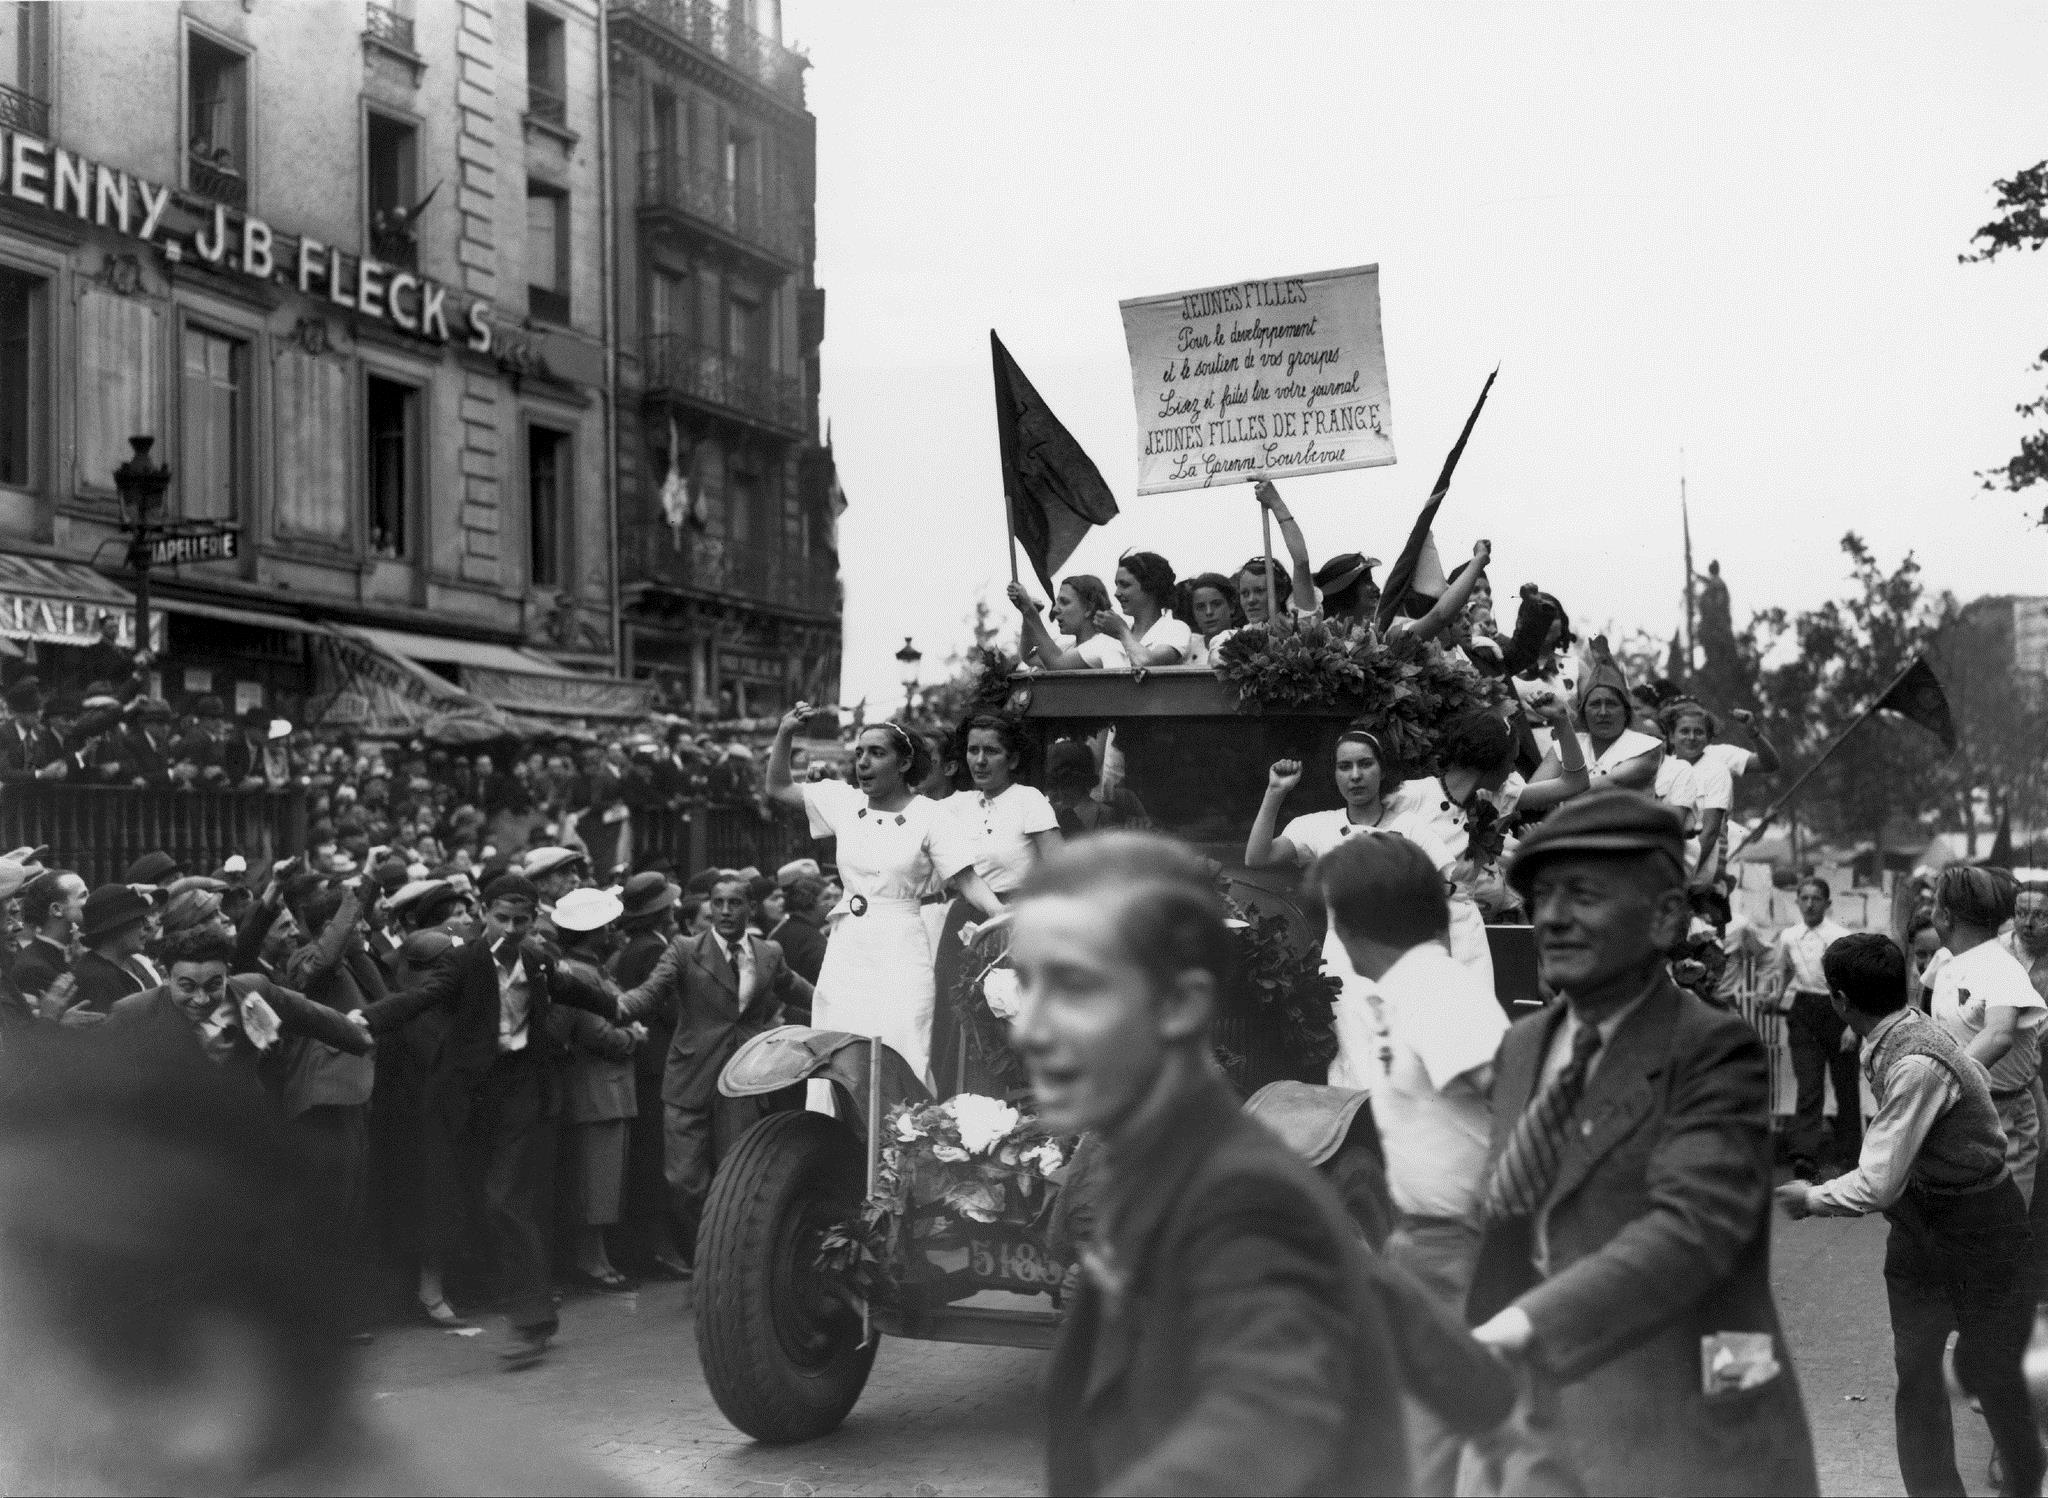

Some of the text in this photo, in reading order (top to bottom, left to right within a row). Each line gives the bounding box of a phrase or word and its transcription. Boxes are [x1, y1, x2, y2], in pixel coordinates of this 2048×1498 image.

[299, 235, 448, 341] FLECK
[1181, 278, 1307, 320] JEUNES FILLES
[1178, 316, 1317, 351] Pour le developpement
[1163, 347, 1341, 382] et le soutien de vos groupes
[1158, 370, 1361, 424] Lisez et faites lire votre journal
[1145, 424, 1204, 455] JEUNES
[1208, 414, 1268, 446] FILLES
[1272, 411, 1299, 438] DE
[1169, 453, 1198, 480] La
